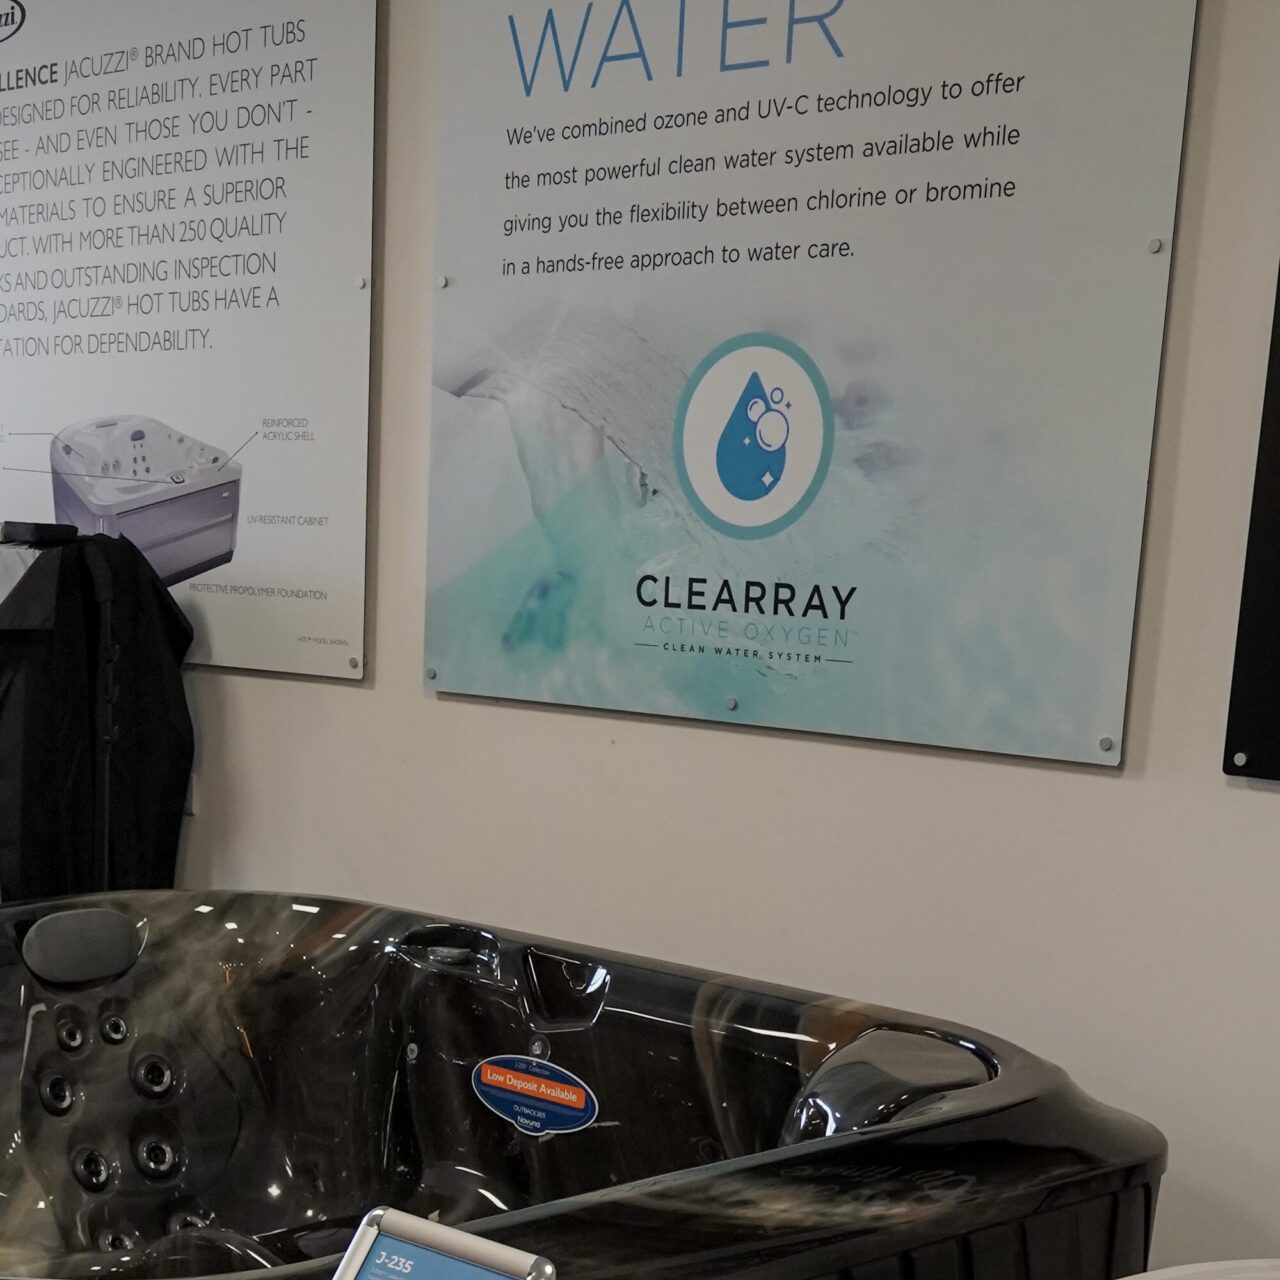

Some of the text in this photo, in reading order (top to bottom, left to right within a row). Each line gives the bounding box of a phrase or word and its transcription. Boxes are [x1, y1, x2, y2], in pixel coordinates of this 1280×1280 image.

[145, 37, 205, 68] BRAND
[213, 28, 253, 56] HOT
[259, 19, 305, 48] TUBS
[508, 0, 843, 97] WATER
[71, 93, 101, 117] FOR
[108, 76, 201, 110] RELIABILITY.
[210, 67, 263, 96] EVERY
[271, 58, 318, 87] PART
[35, 133, 71, 156] AND
[77, 125, 116, 150] EVEN
[125, 116, 180, 143] THOSE
[188, 109, 228, 134] YOU
[237, 99, 298, 129] DON'T
[507, 72, 1025, 145] We've combined ozone and UV-C technology to offer
[103, 149, 207, 182] ENGINEERED
[215, 141, 264, 167] WITH
[273, 136, 312, 161] THE
[505, 124, 1020, 189] the most powerful clean water system available while
[82, 196, 106, 218] TO
[114, 188, 176, 216] ENSURE
[184, 187, 196, 208] A
[203, 177, 287, 206] SUPERIOR
[504, 177, 1015, 236] giving you the flexibility between chlorine or bromine
[32, 232, 72, 255] WITH
[80, 227, 124, 251] MORE
[127, 222, 175, 246] THAN
[179, 219, 206, 242] 250
[210, 211, 287, 243] QUALITY
[14, 270, 48, 292] AND
[51, 260, 168, 289] OUTSTANDING
[175, 251, 276, 280] INSPECTION
[503, 242, 854, 276] in a hands-free approach to water care.
[128, 292, 164, 315] HOT
[168, 290, 209, 312] TUBS
[215, 286, 261, 310] HAVE
[265, 286, 279, 308] A
[54, 335, 84, 355] FOR
[88, 328, 212, 354] DEPENDABILITY.
[262, 418, 308, 428] REINFORCED
[263, 431, 314, 441] ACRYLIC SHELL
[247, 515, 328, 526] UV-RESISTANT CABINET
[189, 583, 327, 600] PROTECTIVE PROPOLYMER FOUNDATION
[637, 575, 857, 620] CLEARRAY
[643, 616, 728, 638] ACTIVE
[664, 643, 821, 663] CLEAN WATER SYSTEM
[488, 1070, 577, 1102] Low Deposit Available
[376, 1251, 414, 1273] J-235
